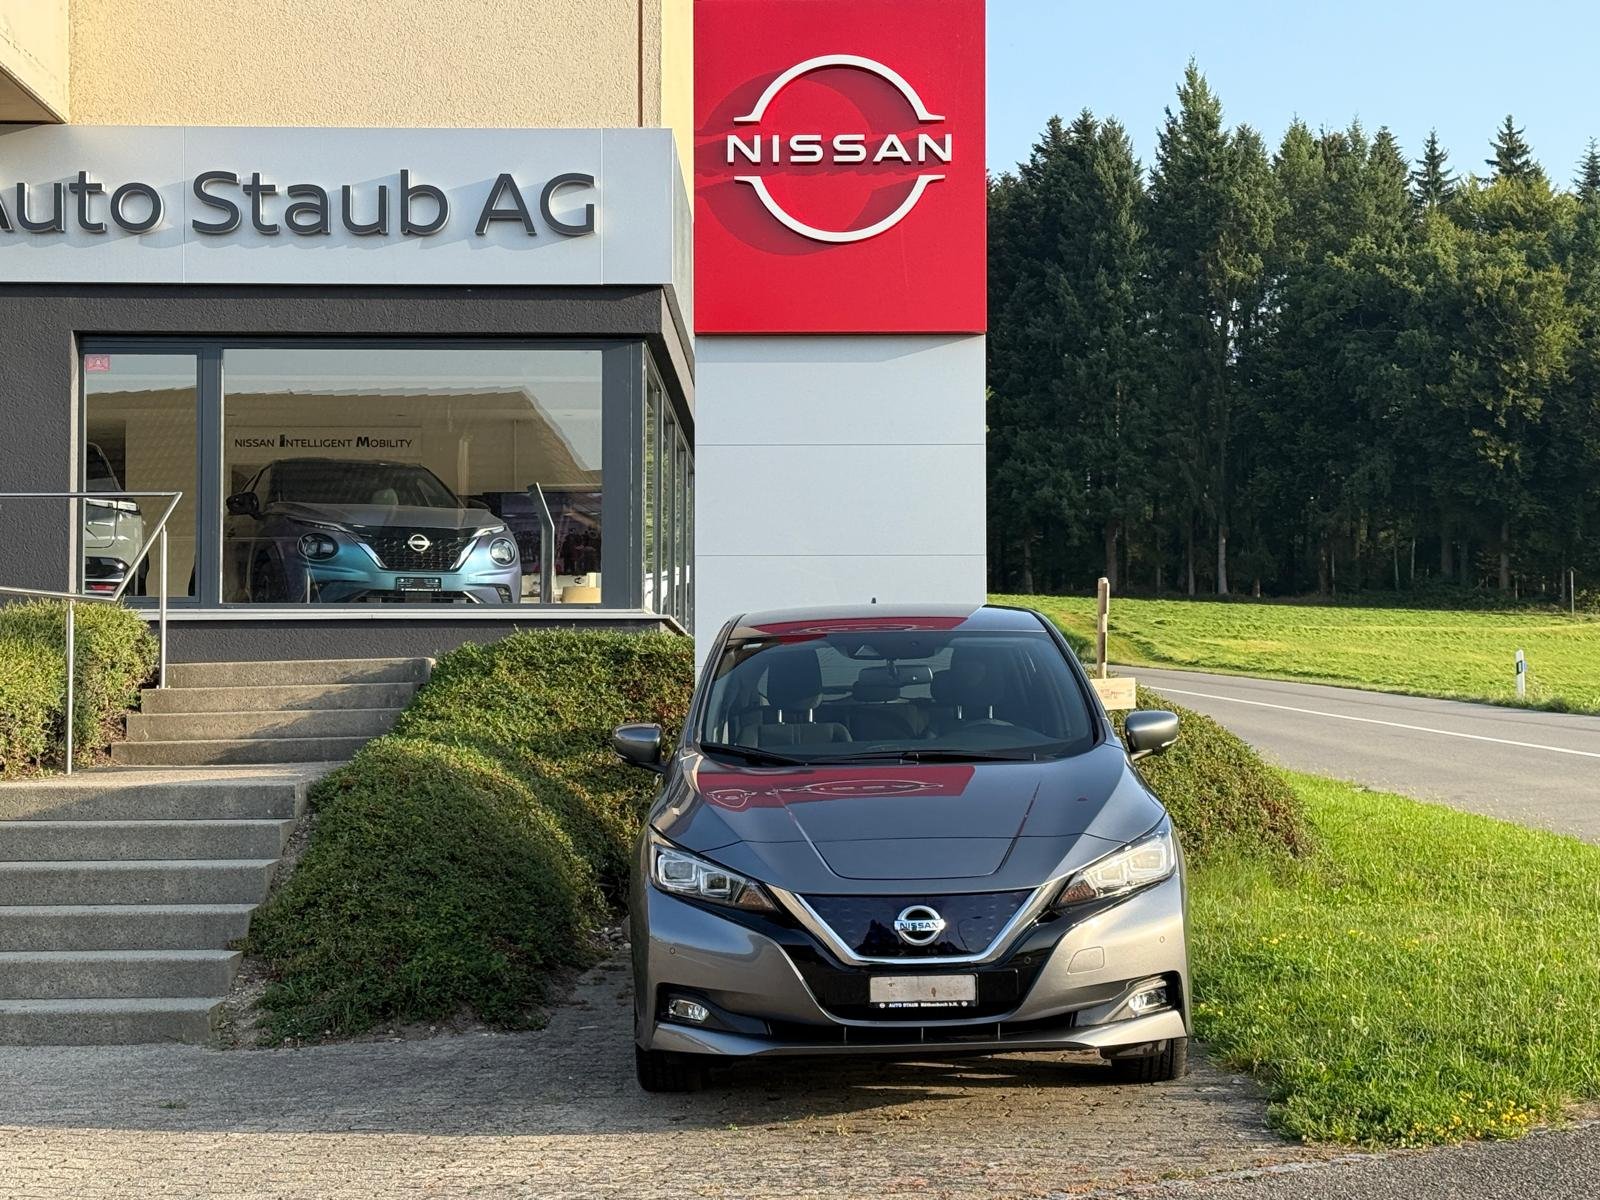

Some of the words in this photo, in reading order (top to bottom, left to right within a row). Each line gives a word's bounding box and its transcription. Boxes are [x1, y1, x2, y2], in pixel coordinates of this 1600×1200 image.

[726, 133, 953, 165] NISSAN
[0, 170, 165, 234] uto
[191, 169, 450, 236] Staub
[474, 172, 596, 237] AG
[234, 438, 275, 448] NISSAN
[279, 434, 352, 448] INTELLIGENT
[355, 436, 413, 448] MOBILITY
[899, 922, 939, 930] NISSAN
